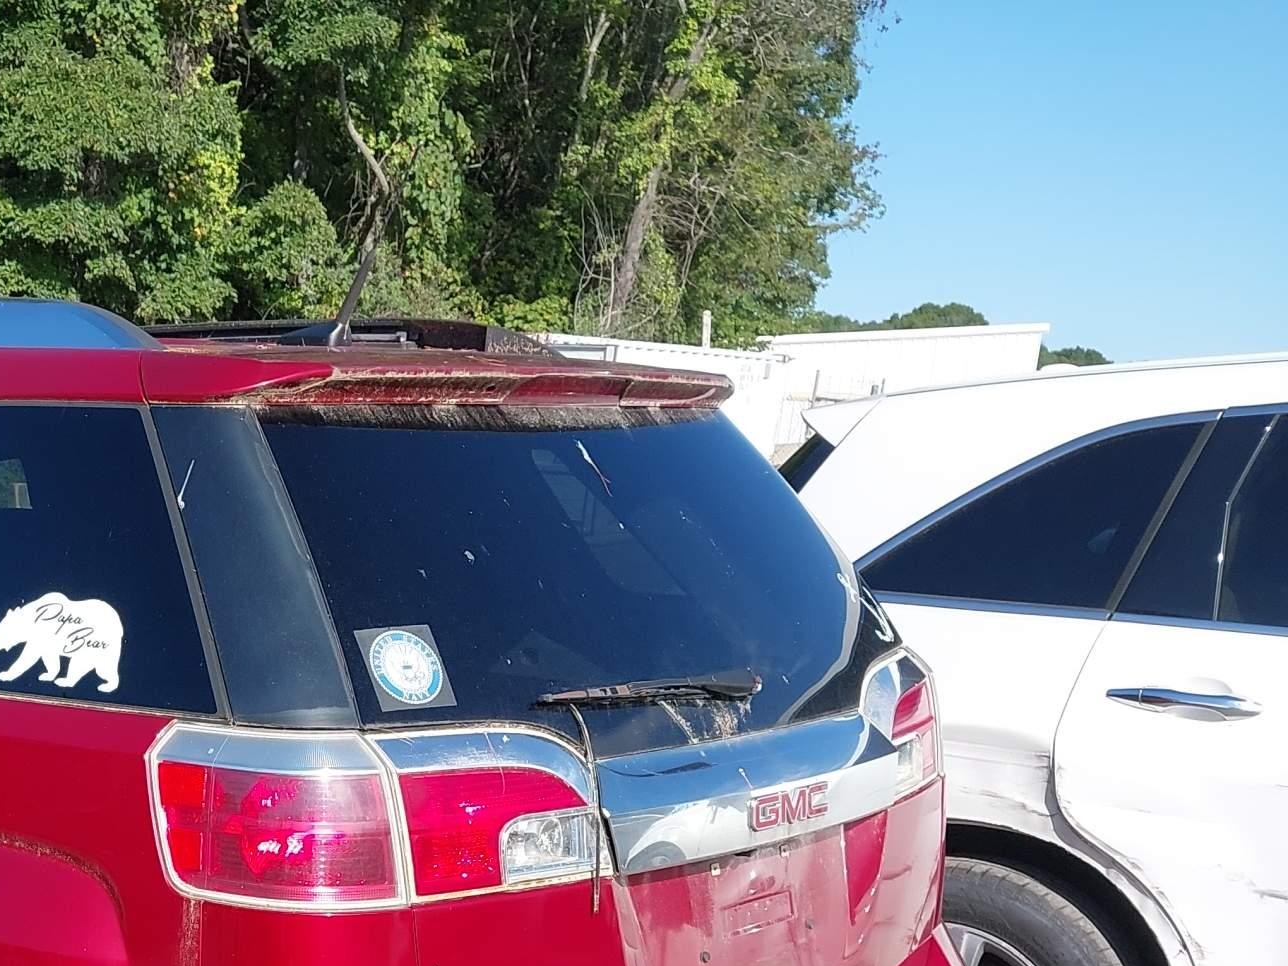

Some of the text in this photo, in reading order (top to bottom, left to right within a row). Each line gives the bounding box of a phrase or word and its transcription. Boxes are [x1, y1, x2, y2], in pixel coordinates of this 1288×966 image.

[34, 602, 84, 635] Papa
[63, 627, 110, 653] Bear
[750, 781, 829, 831] GMC
